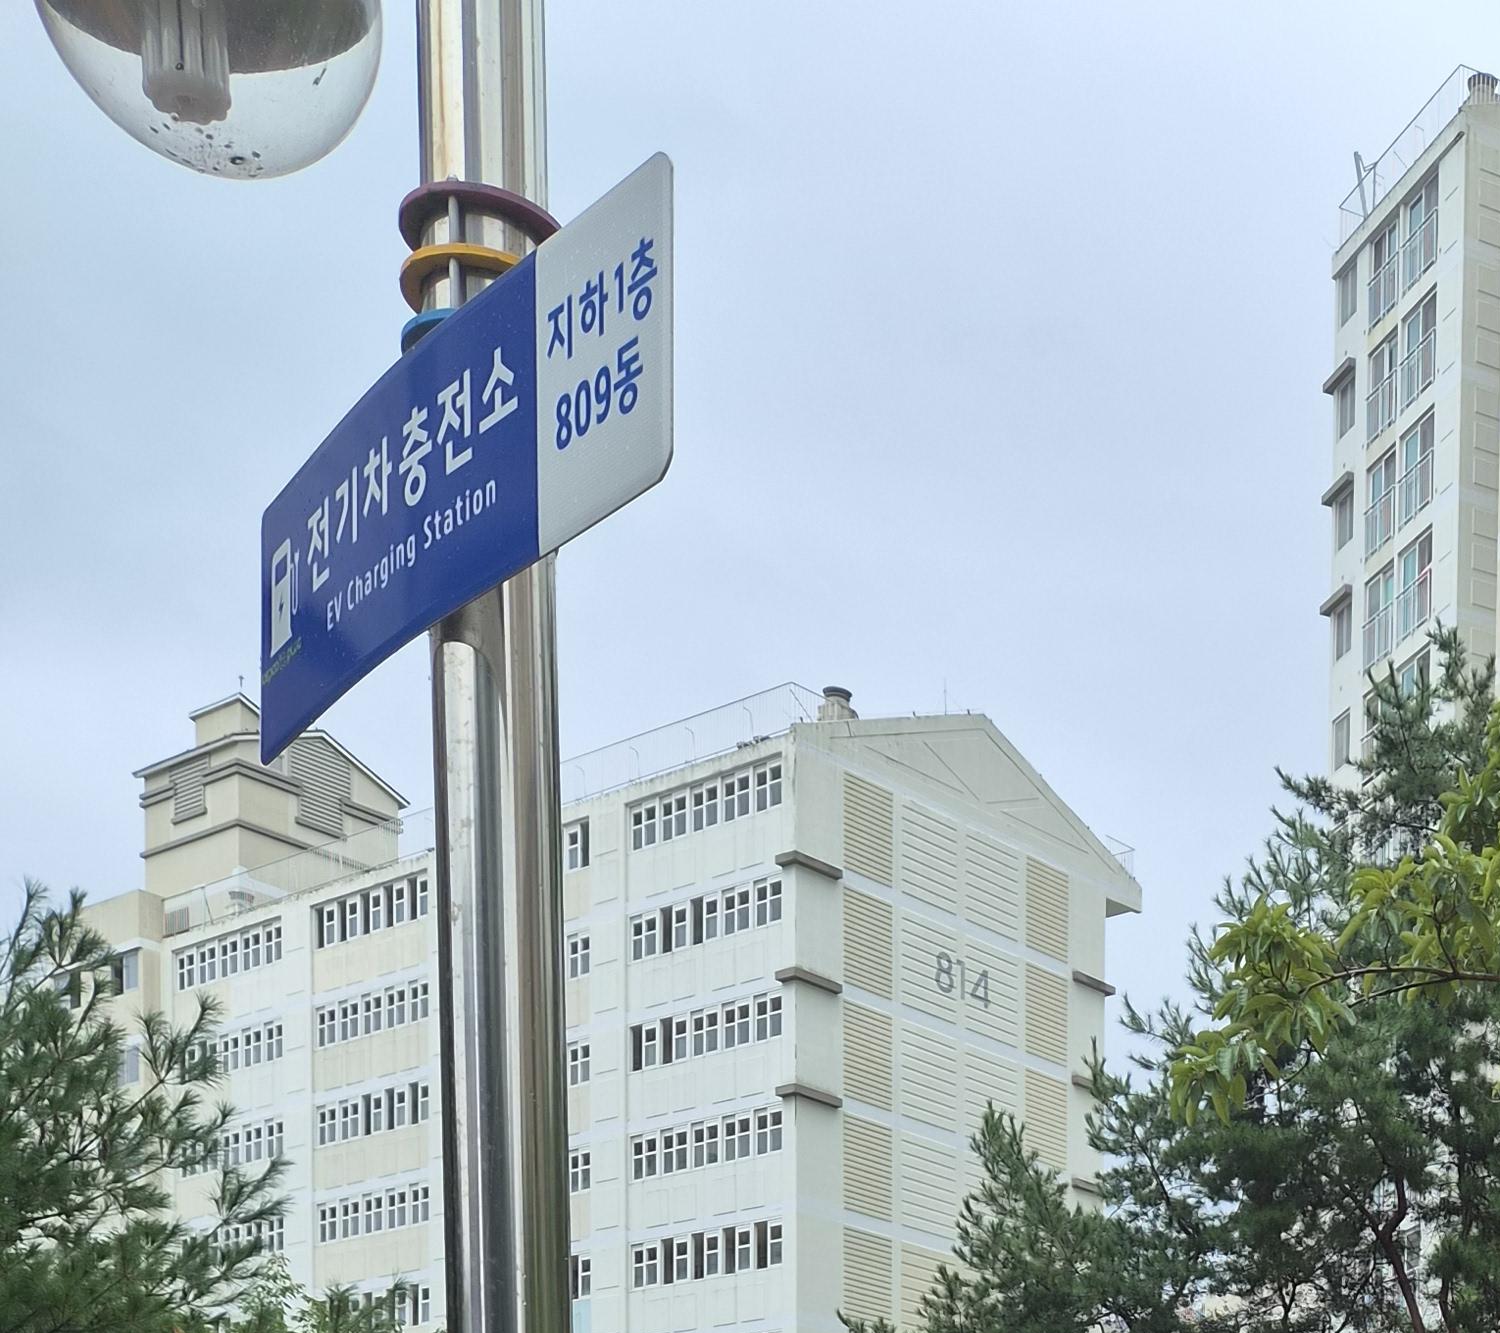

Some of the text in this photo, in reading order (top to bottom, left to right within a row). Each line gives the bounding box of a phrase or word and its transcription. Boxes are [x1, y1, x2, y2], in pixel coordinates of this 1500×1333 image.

[556, 336, 643, 450] 809동
[326, 480, 497, 632] EV Charging Station
[935, 951, 991, 1009] 814
